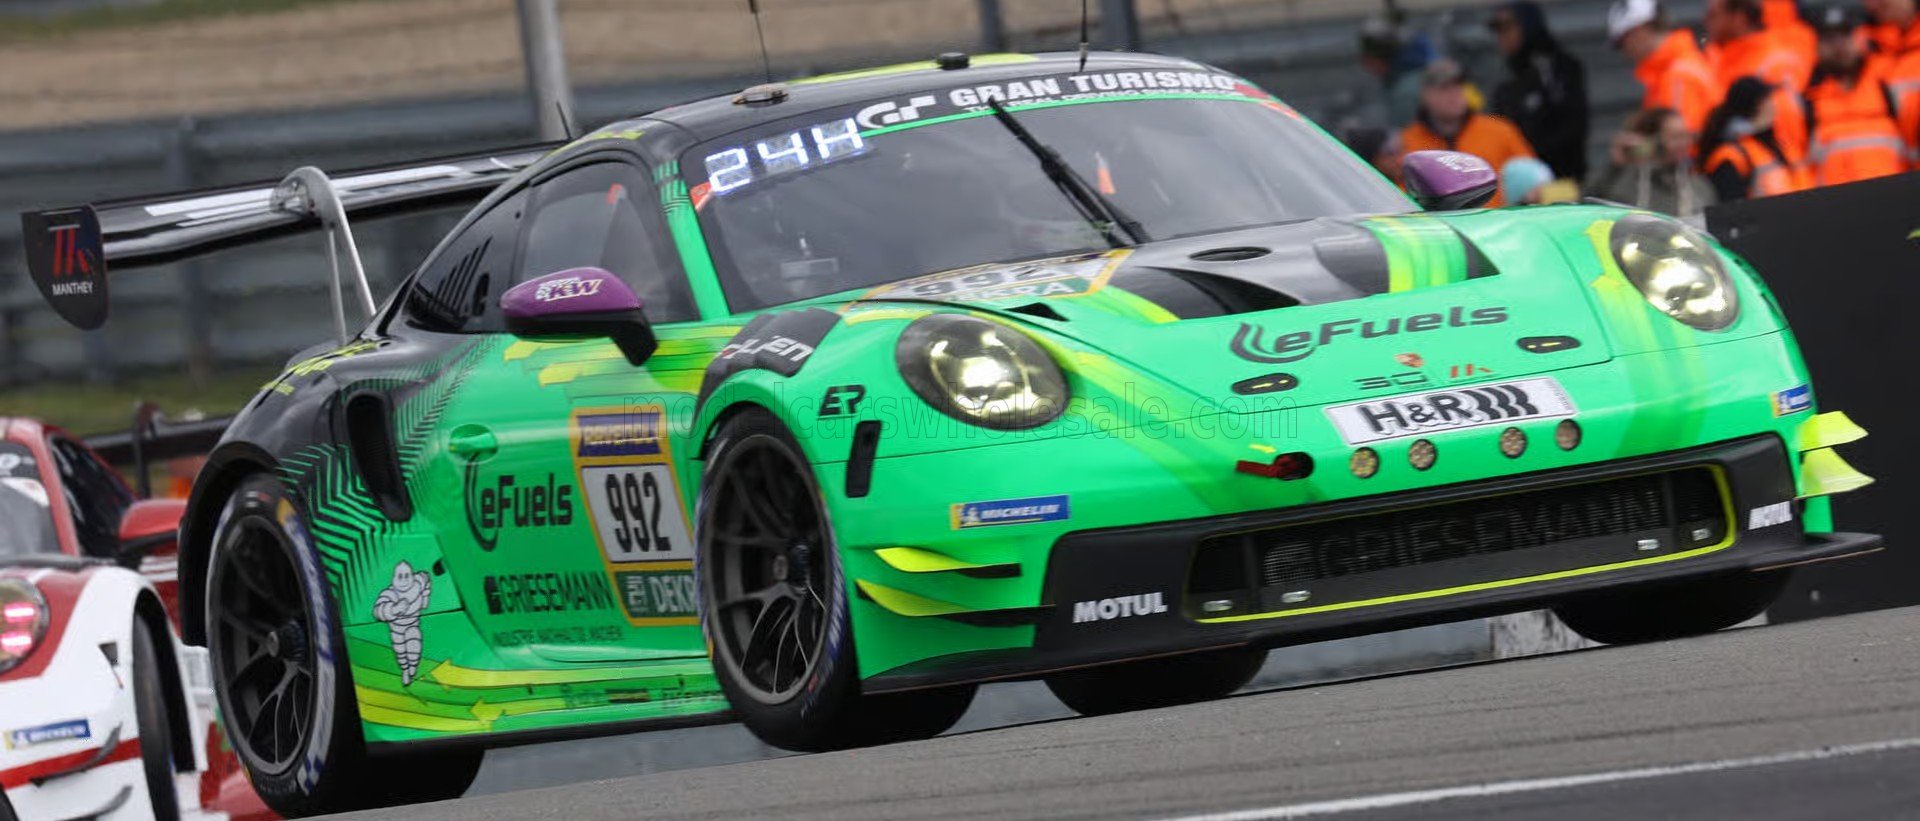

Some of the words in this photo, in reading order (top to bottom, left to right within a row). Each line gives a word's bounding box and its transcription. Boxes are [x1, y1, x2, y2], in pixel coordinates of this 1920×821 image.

[950, 78, 1061, 108] GRAN
[1069, 71, 1236, 92] TURISMO
[704, 117, 864, 196] 24H
[52, 281, 94, 296] MANTHEY
[1358, 393, 1474, 436] H&R
[480, 472, 572, 529] eFuels
[604, 471, 672, 553] 992
[979, 503, 1061, 520] MICHELIN
[497, 570, 615, 613] GRIESEMANN
[1072, 592, 1168, 624] MOTUL
